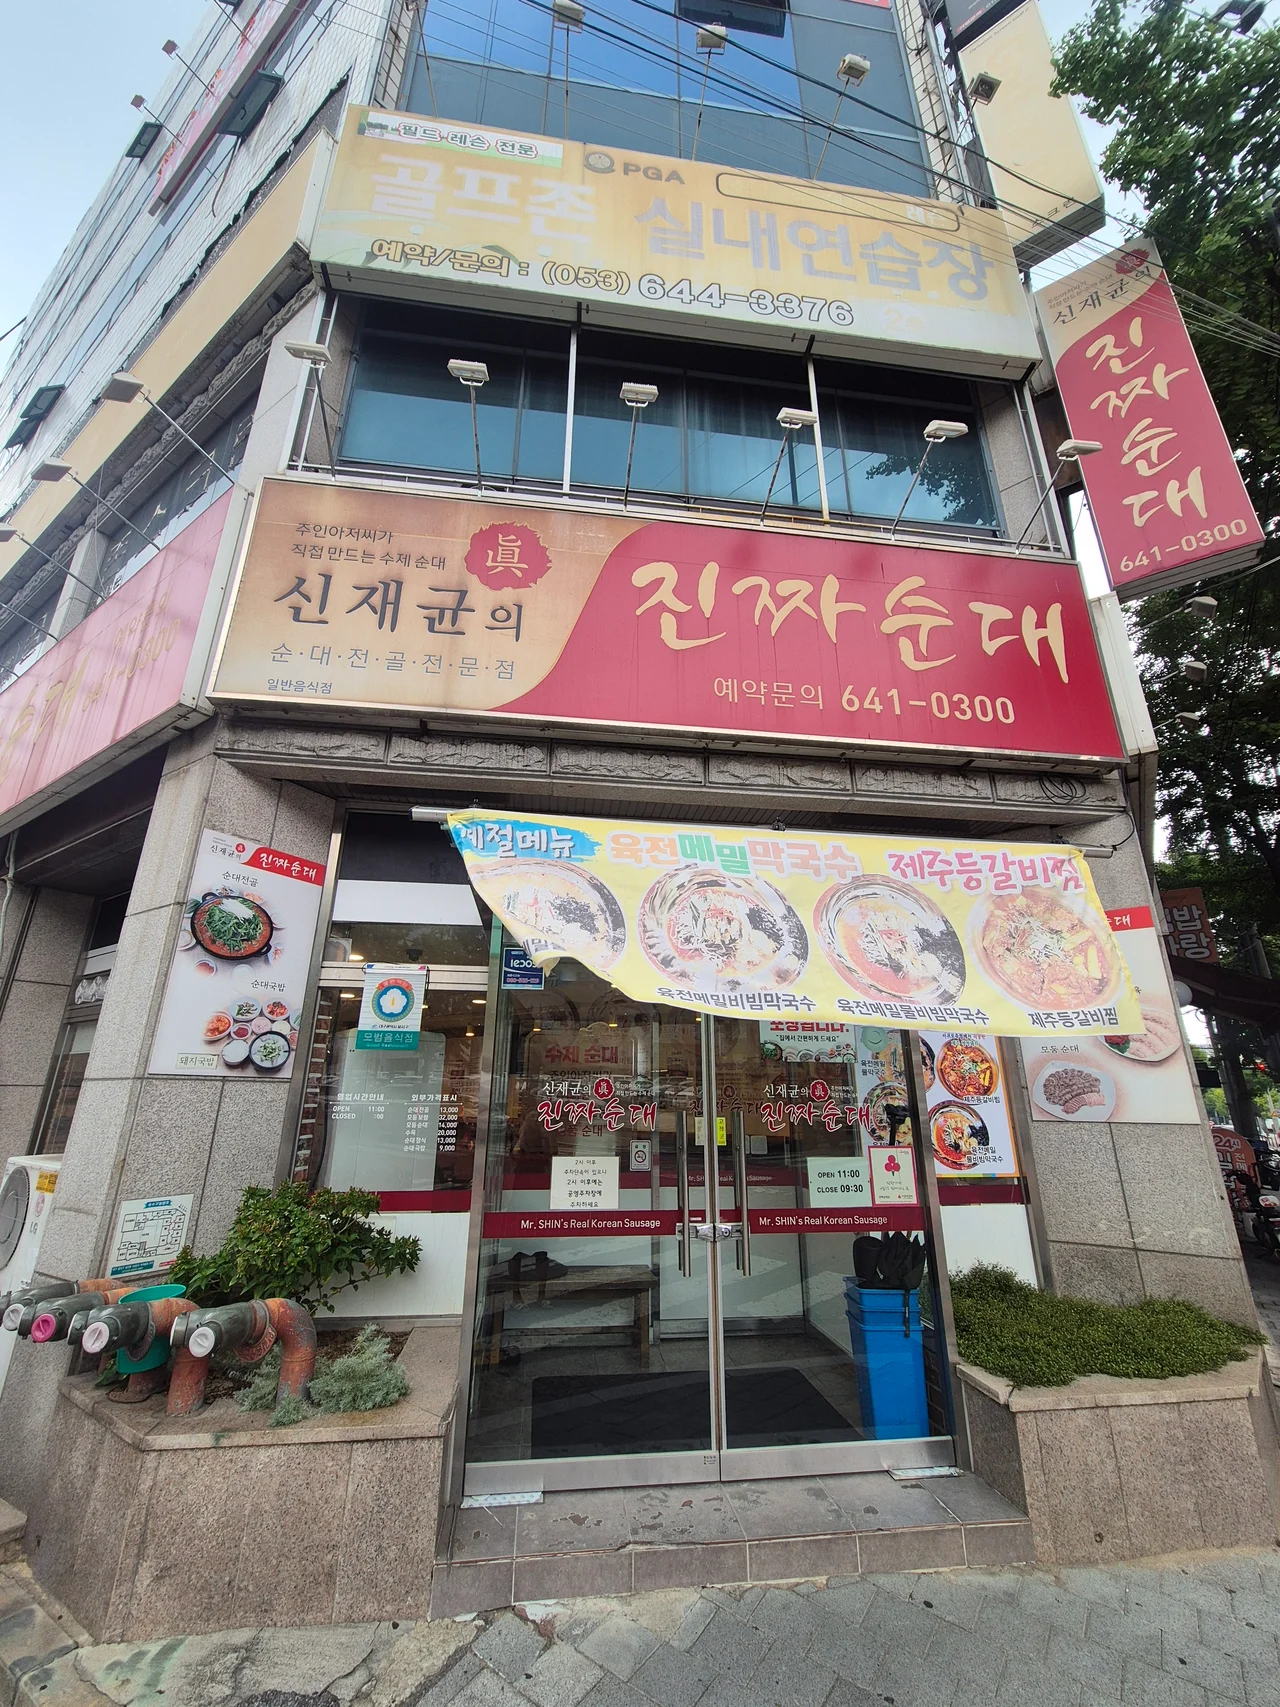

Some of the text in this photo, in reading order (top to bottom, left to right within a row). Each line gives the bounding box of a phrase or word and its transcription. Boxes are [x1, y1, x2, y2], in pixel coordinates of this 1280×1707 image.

[496, 138, 538, 157] 전문
[623, 162, 685, 185] PGA
[370, 154, 597, 246] 골프존
[634, 195, 995, 301] 실내연습장
[371, 239, 510, 278] 예약/문의
[541, 261, 631, 295] (053)
[638, 272, 855, 327] 644-3376
[1053, 265, 1151, 325] 신재균의
[1085, 316, 1208, 527] 진짜순대
[295, 523, 394, 545] 주인아저씨가
[291, 543, 447, 572] 직접 만드는 수제 순대
[1120, 518, 1248, 574] 641-0300
[274, 572, 524, 643] 신재균의
[631, 560, 1070, 684] 진짜순대
[266, 677, 333, 696] 일반음식점
[713, 676, 1017, 724] 예약문의 641-0300
[260, 852, 317, 882] 진짜순대
[609, 832, 859, 880] 육전메밀막국수
[221, 870, 258, 887] 순대전골
[888, 848, 1087, 893] 제주등갈비찜
[250, 979, 286, 993] 순대국밥
[656, 985, 817, 1013] 육전메밀비빔막국수
[836, 997, 990, 1026] 육전메밀물비빔막국수
[1028, 1006, 1119, 1029] 제주등갈비찜
[363, 1032, 414, 1044] 모범음식점
[1060, 1044, 1080, 1054] 순대
[179, 1055, 216, 1067] 돼지국밥
[584, 1044, 619, 1064] 순대
[411, 1094, 457, 1102] 외부가격표시
[763, 1083, 810, 1098] 신재균의
[537, 1097, 657, 1132] 진짜순대
[761, 1099, 871, 1132] 진짜순대
[837, 1169, 860, 1179] 11:00
[840, 1184, 864, 1193] 09:30
[30, 1221, 39, 1235] LG
[520, 1218, 661, 1230] Mr. SHIN's Real Korean Sausage
[759, 1215, 888, 1227] Mr. SHIN's Real Korean Sausage
